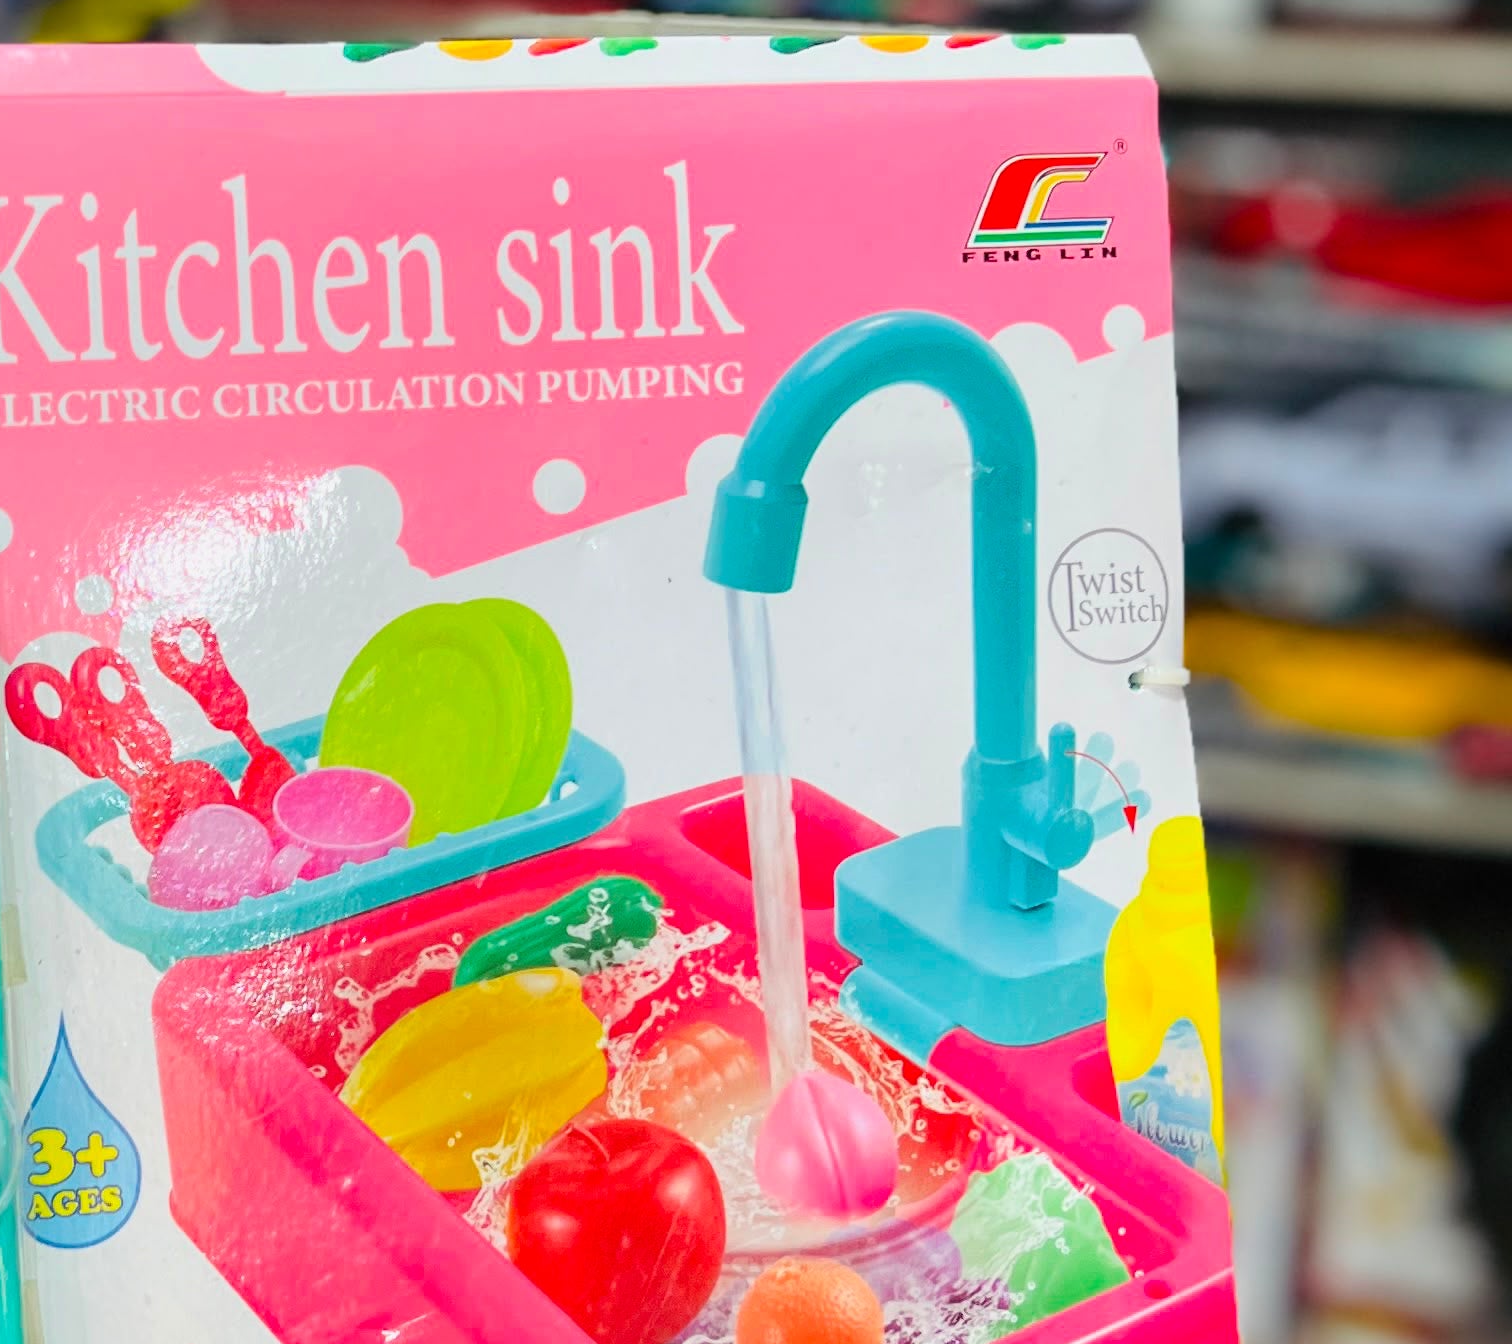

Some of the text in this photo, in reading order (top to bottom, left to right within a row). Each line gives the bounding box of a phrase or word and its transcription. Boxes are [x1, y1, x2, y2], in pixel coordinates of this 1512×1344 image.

[496, 159, 745, 346] sink
[962, 247, 1118, 263] FENG LIN
[212, 370, 525, 419] CIRCULATION
[537, 361, 745, 404] PUMPING
[1055, 561, 1146, 632] Twist
[1078, 594, 1164, 627] Switch
[27, 1126, 120, 1188] 3+
[27, 1185, 123, 1221] AGES
